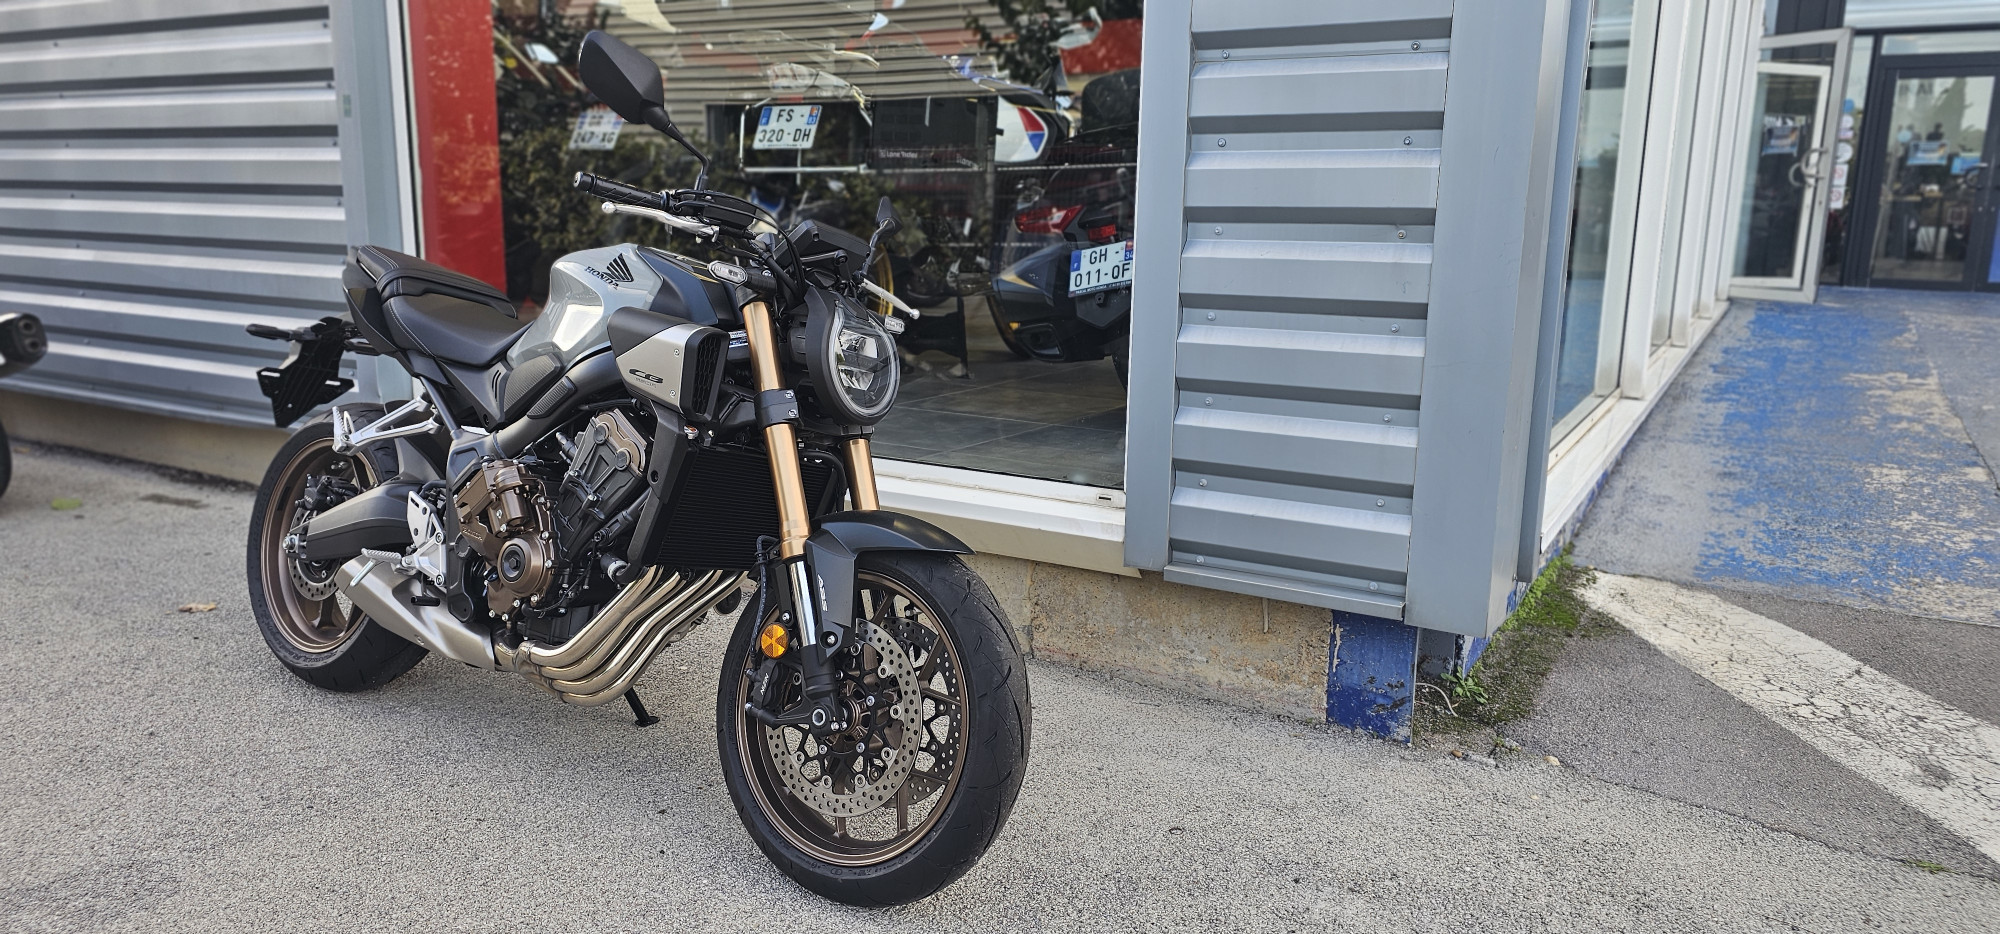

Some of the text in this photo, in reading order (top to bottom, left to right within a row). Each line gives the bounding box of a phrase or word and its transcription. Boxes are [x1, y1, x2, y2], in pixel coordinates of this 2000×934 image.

[776, 109, 794, 122] FS
[1090, 248, 1107, 265] GH
[585, 266, 619, 290] HONDA
[1075, 262, 1131, 287] 011-QF
[629, 369, 663, 383] CB
[817, 573, 828, 611] ABS
